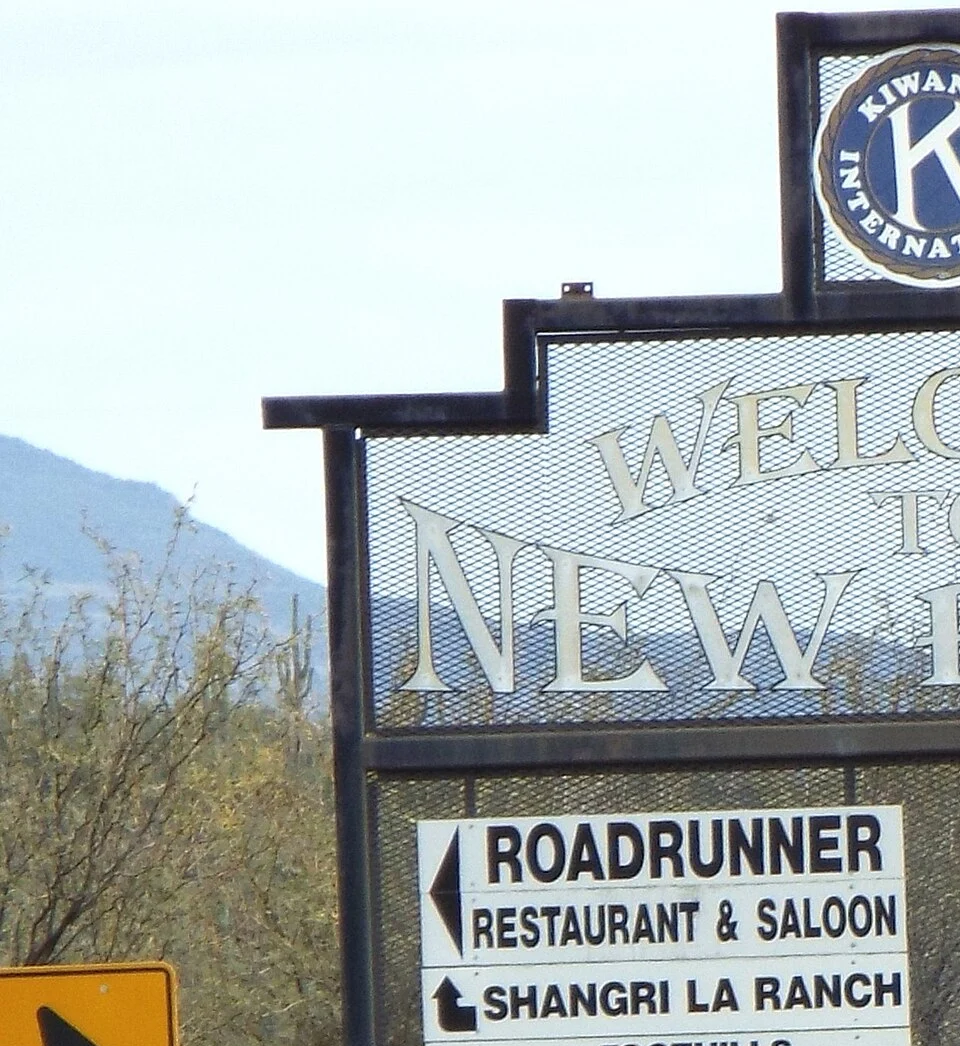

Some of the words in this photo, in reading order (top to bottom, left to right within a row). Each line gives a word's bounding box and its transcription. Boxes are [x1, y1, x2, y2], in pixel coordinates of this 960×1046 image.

[401, 496, 862, 695] NEW
[487, 814, 882, 884] ROADRUNNER
[473, 902, 699, 949] RESTAURANT
[716, 901, 738, 940] &
[758, 895, 896, 940] SALOON
[484, 981, 669, 1021] SHANGRI
[687, 979, 733, 1013] LA
[755, 973, 901, 1011] RANCH
